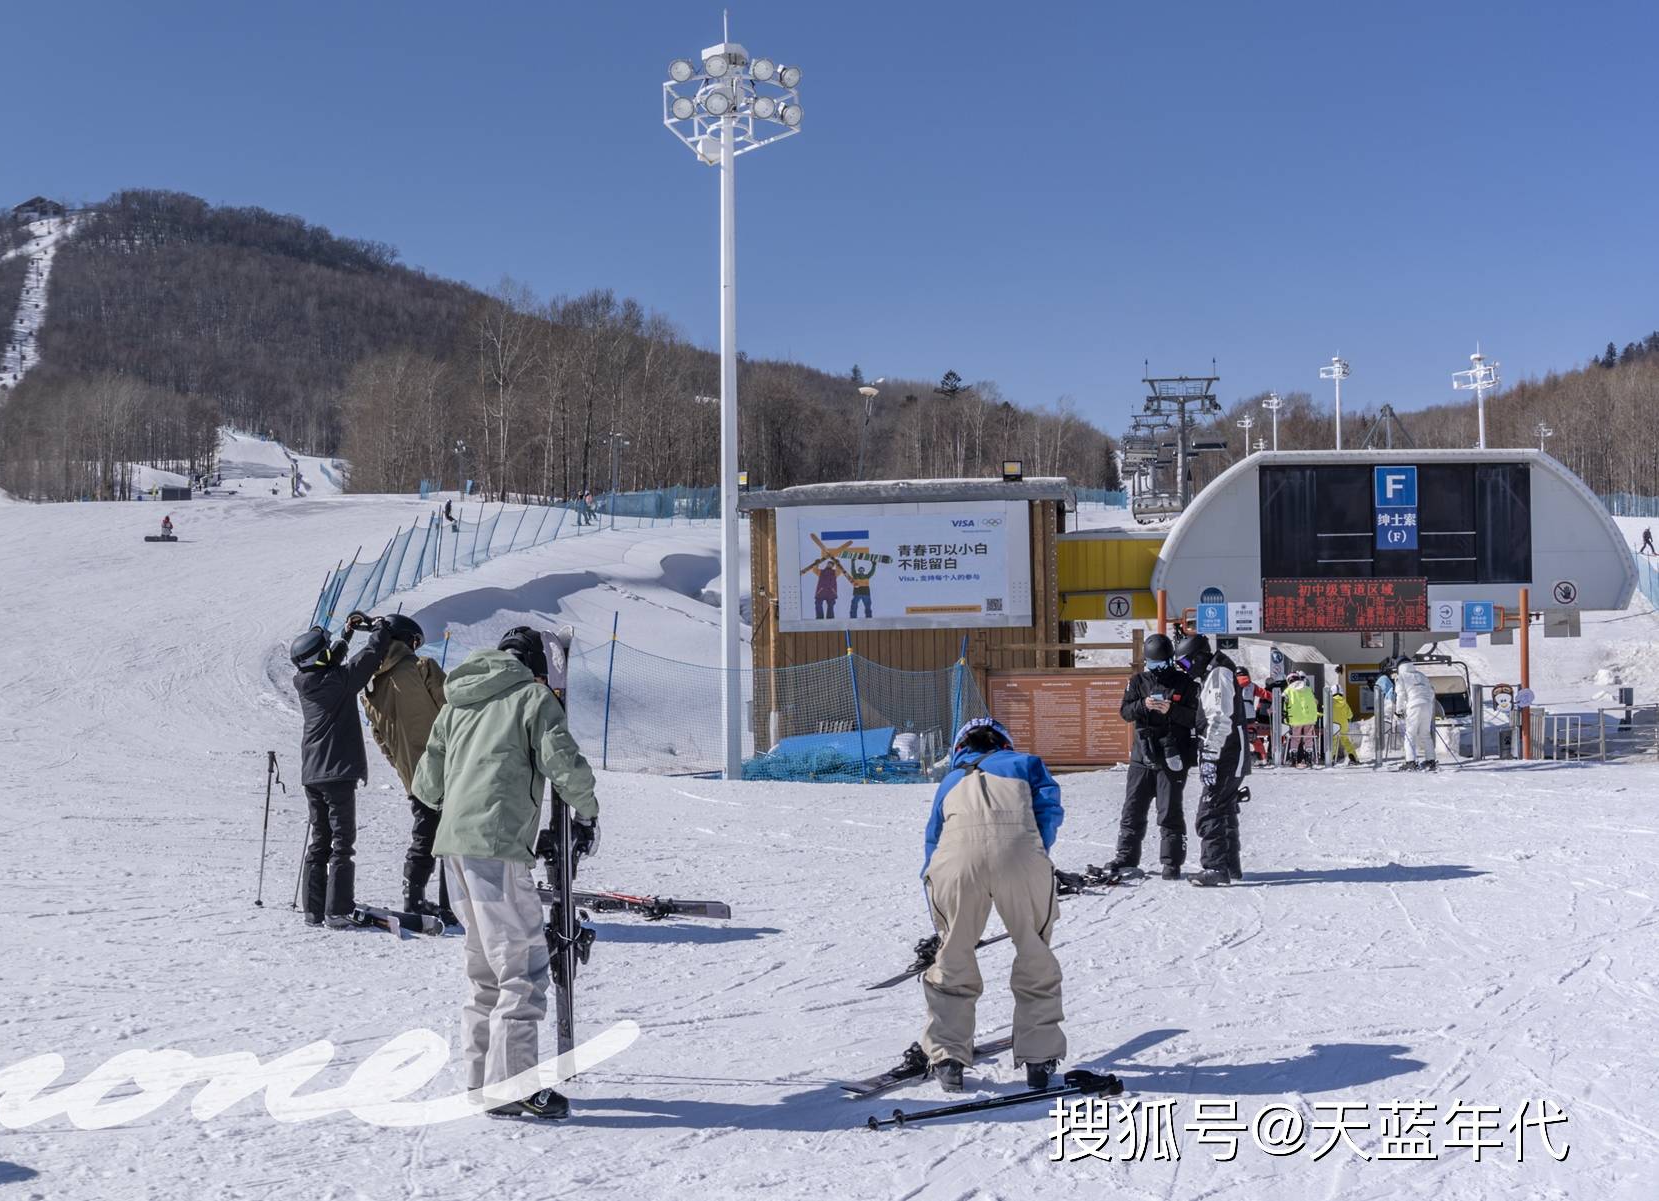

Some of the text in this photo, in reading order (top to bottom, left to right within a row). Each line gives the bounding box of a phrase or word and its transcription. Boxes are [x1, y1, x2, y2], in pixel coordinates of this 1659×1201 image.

[1386, 475, 1406, 498] F
[898, 543, 988, 557] 青春可以小白
[898, 557, 957, 571] 不能留白
[1298, 583, 1395, 597] 初中级雪道区域
